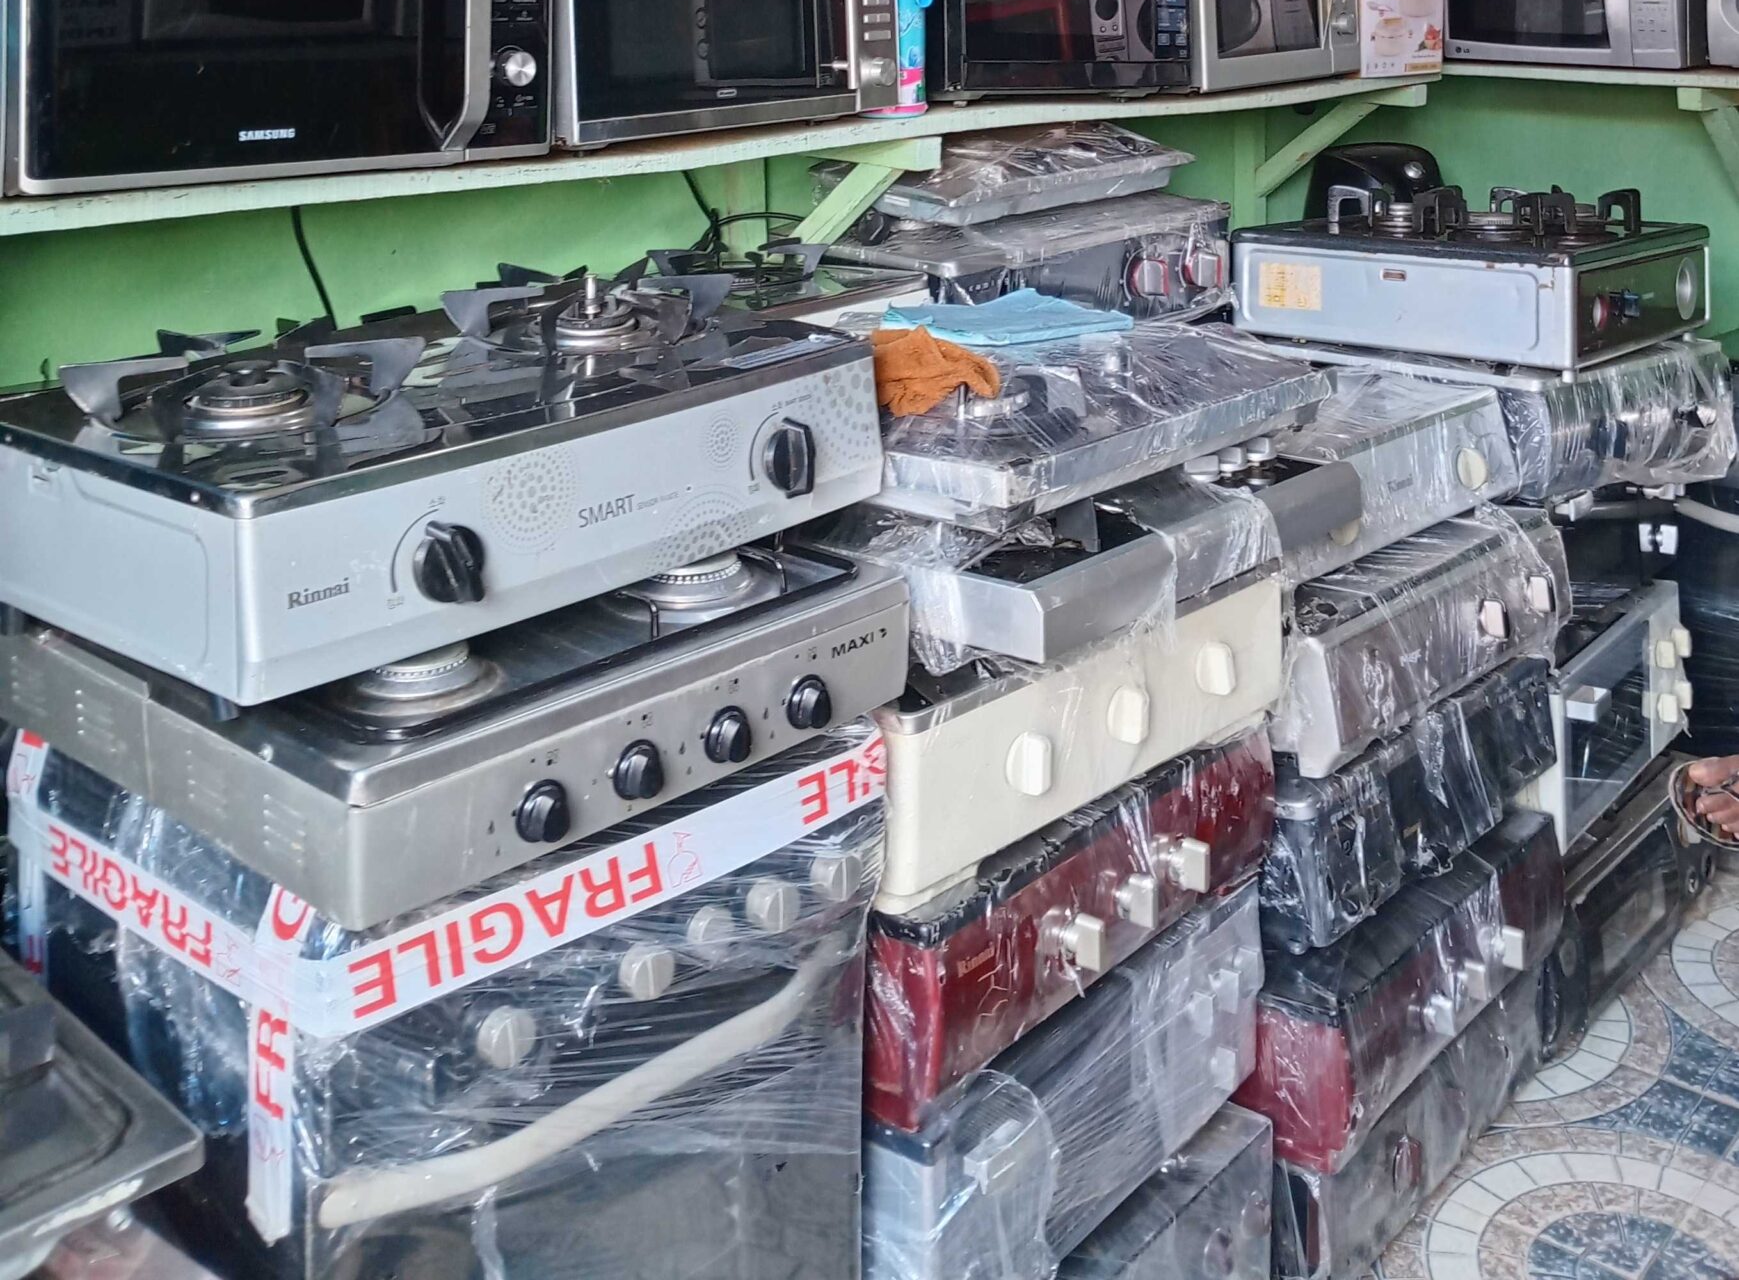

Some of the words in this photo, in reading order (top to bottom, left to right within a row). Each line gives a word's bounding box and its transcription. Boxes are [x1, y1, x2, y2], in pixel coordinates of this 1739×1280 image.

[238, 128, 296, 141] SAMSUNG
[578, 494, 635, 528] SMART
[287, 577, 350, 610] Rinnai
[831, 631, 875, 659] MAXI
[48, 822, 213, 970] FRAGILE
[347, 841, 664, 1018] FRAGILE
